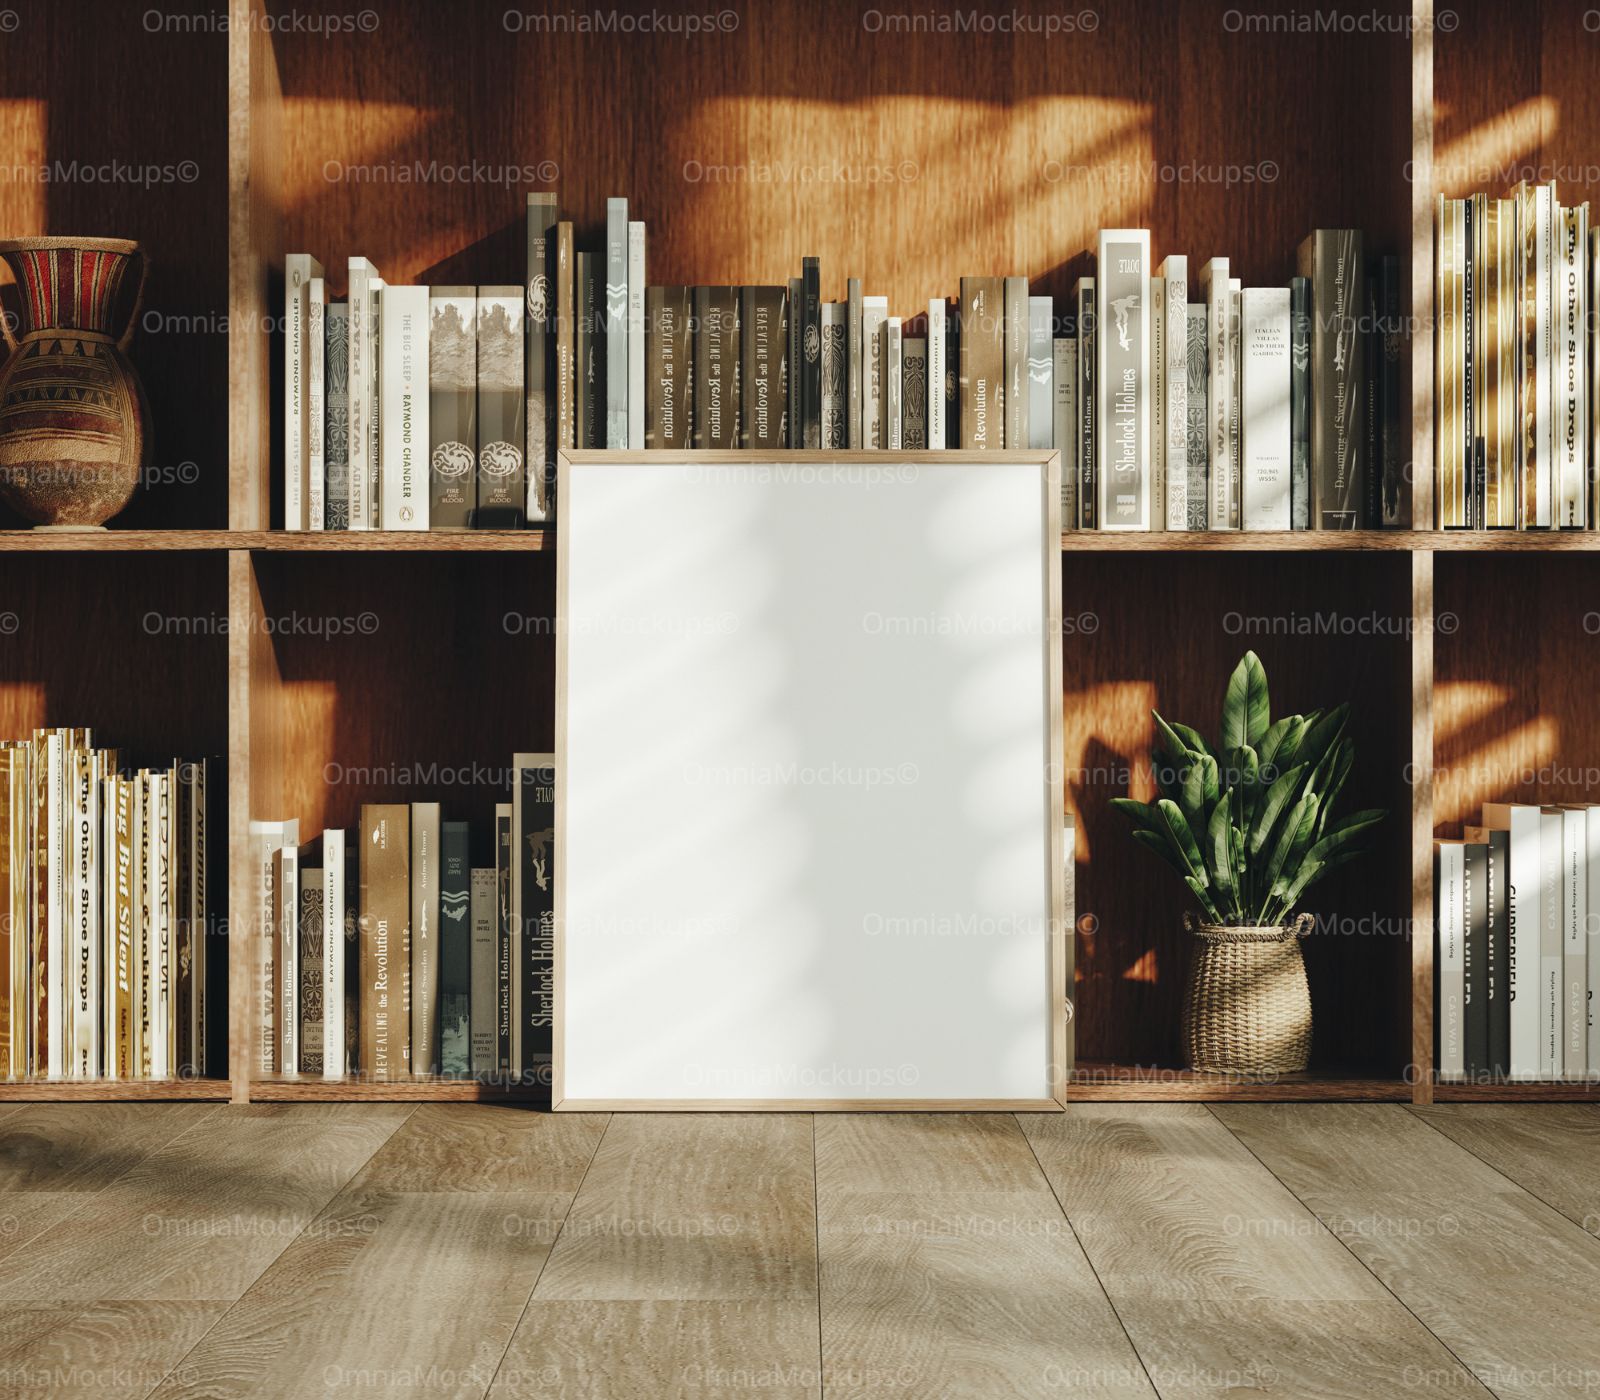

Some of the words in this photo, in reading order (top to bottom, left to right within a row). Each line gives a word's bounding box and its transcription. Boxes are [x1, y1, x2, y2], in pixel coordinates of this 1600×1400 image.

[1119, 260, 1140, 273] DOYLE
[1335, 258, 1344, 284] Brown
[403, 314, 411, 331] THE
[1335, 288, 1344, 318] Andrew
[403, 338, 411, 351] BIG
[403, 355, 411, 381] SLEEP
[872, 332, 880, 399] PEACE
[974, 379, 986, 441] Revolution
[1116, 368, 1136, 413] Holmes
[1335, 382, 1344, 422] Sweden
[403, 395, 411, 444] RAYMOND
[872, 419, 880, 450] AR
[1116, 417, 1136, 472] Sherlock
[1335, 424, 1344, 435] of
[1567, 398, 1575, 463] Drops
[403, 448, 411, 498] CHANDLER
[1335, 436, 1346, 488] Dreaming
[536, 787, 554, 802] OYLE
[119, 841, 129, 897] But
[264, 862, 274, 938] PEACE
[119, 903, 129, 993] Silent
[375, 920, 387, 991] Revolution
[532, 910, 554, 960] Holmes
[80, 946, 88, 1012] Drops
[264, 960, 274, 1017] WAR
[378, 994, 387, 1008] the
[422, 991, 427, 1000] of
[532, 966, 554, 1027] Sherlock
[377, 1013, 387, 1074] REVEALING
